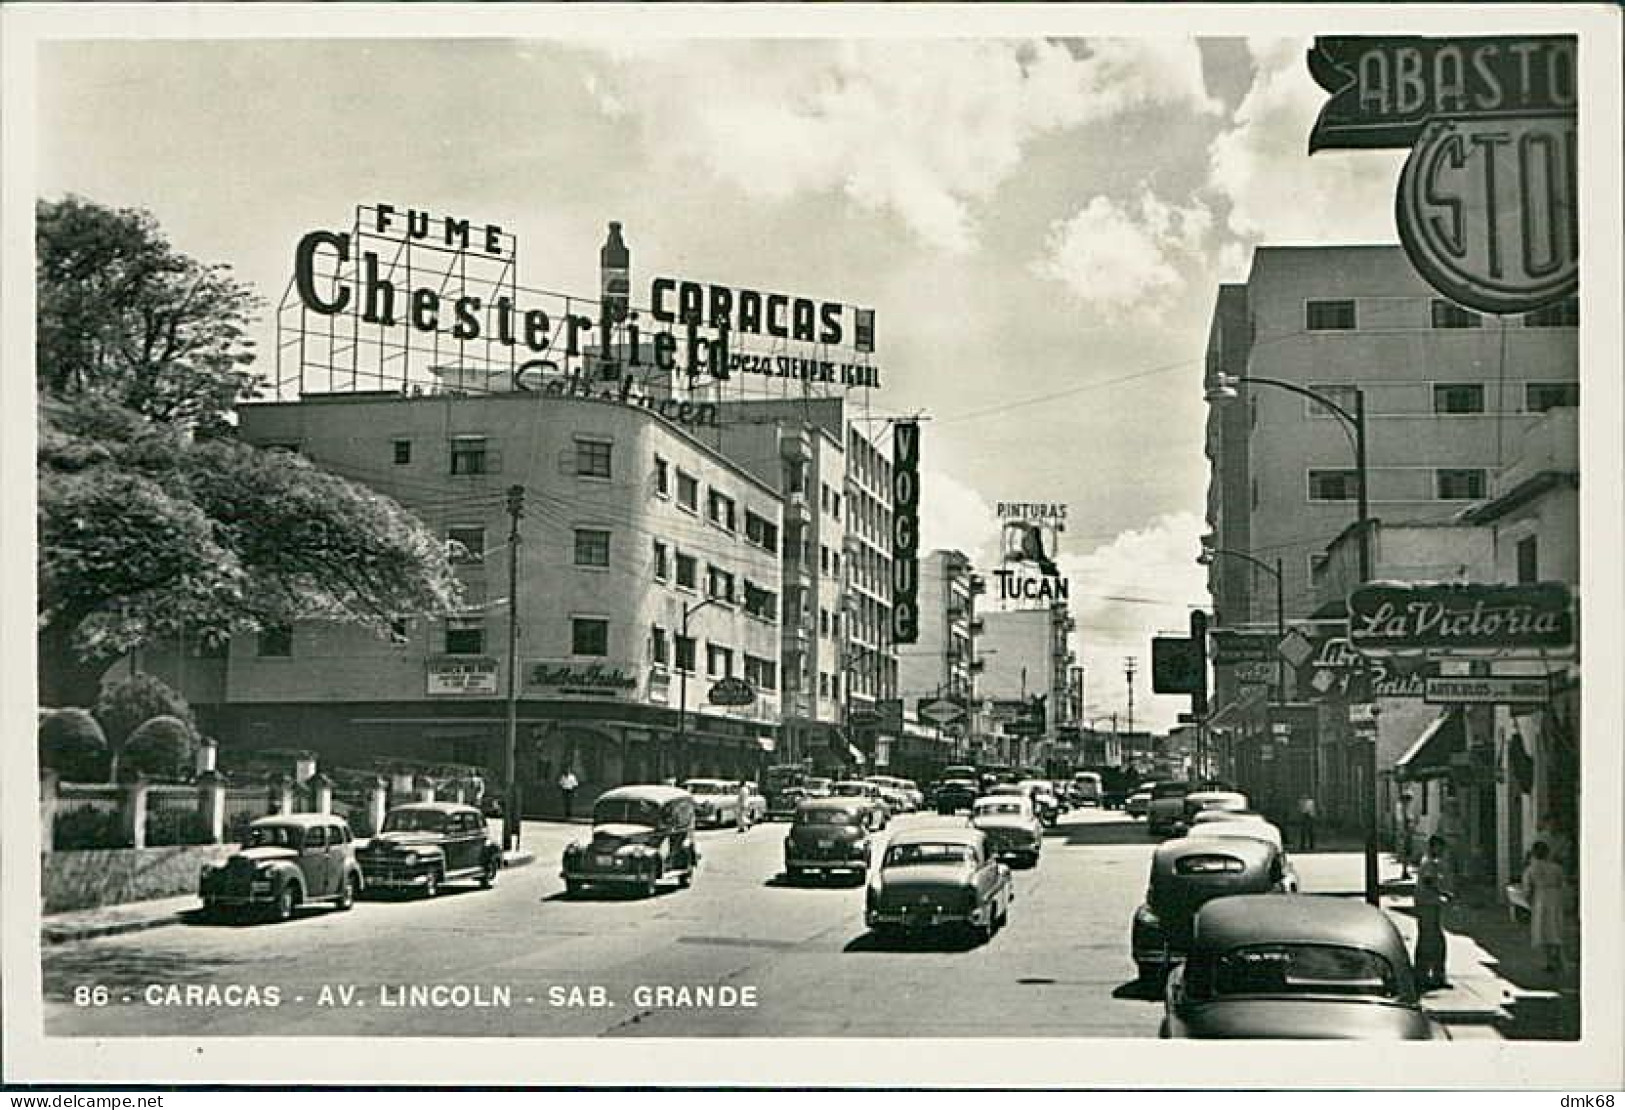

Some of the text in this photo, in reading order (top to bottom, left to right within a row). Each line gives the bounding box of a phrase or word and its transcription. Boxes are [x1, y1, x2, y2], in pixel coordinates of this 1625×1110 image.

[377, 203, 502, 254] FUME
[1424, 132, 1578, 280] STO
[296, 230, 730, 379] Chesterfield
[652, 277, 843, 344] CARACAS
[997, 502, 1068, 518] PINTURAS
[992, 569, 1068, 598] TUCAN
[1353, 601, 1562, 637] La Victoria
